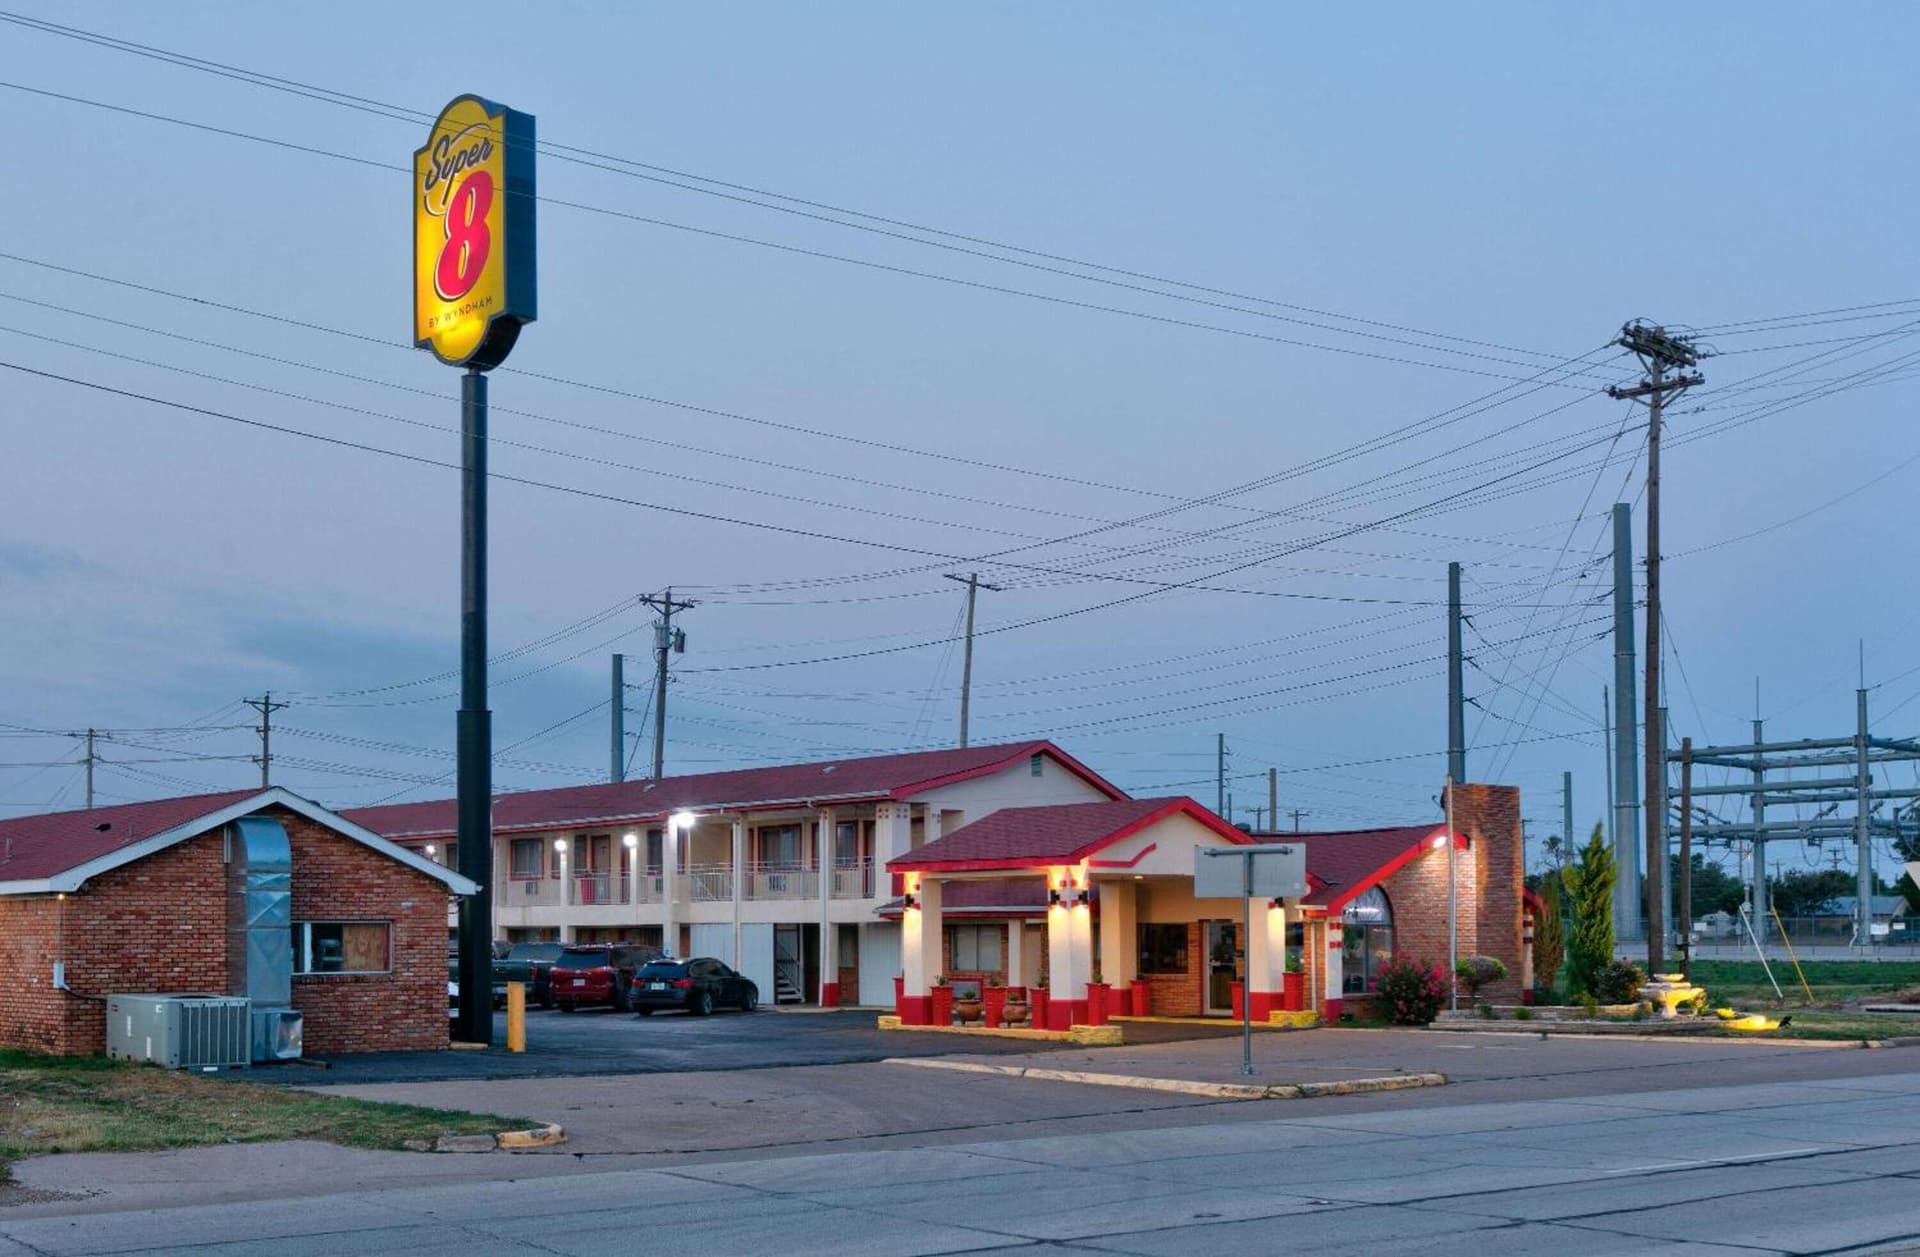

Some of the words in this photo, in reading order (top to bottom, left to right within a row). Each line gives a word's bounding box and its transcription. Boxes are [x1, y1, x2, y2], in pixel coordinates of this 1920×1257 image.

[424, 126, 494, 206] Super
[433, 170, 494, 302] 8
[428, 316, 440, 329] BY
